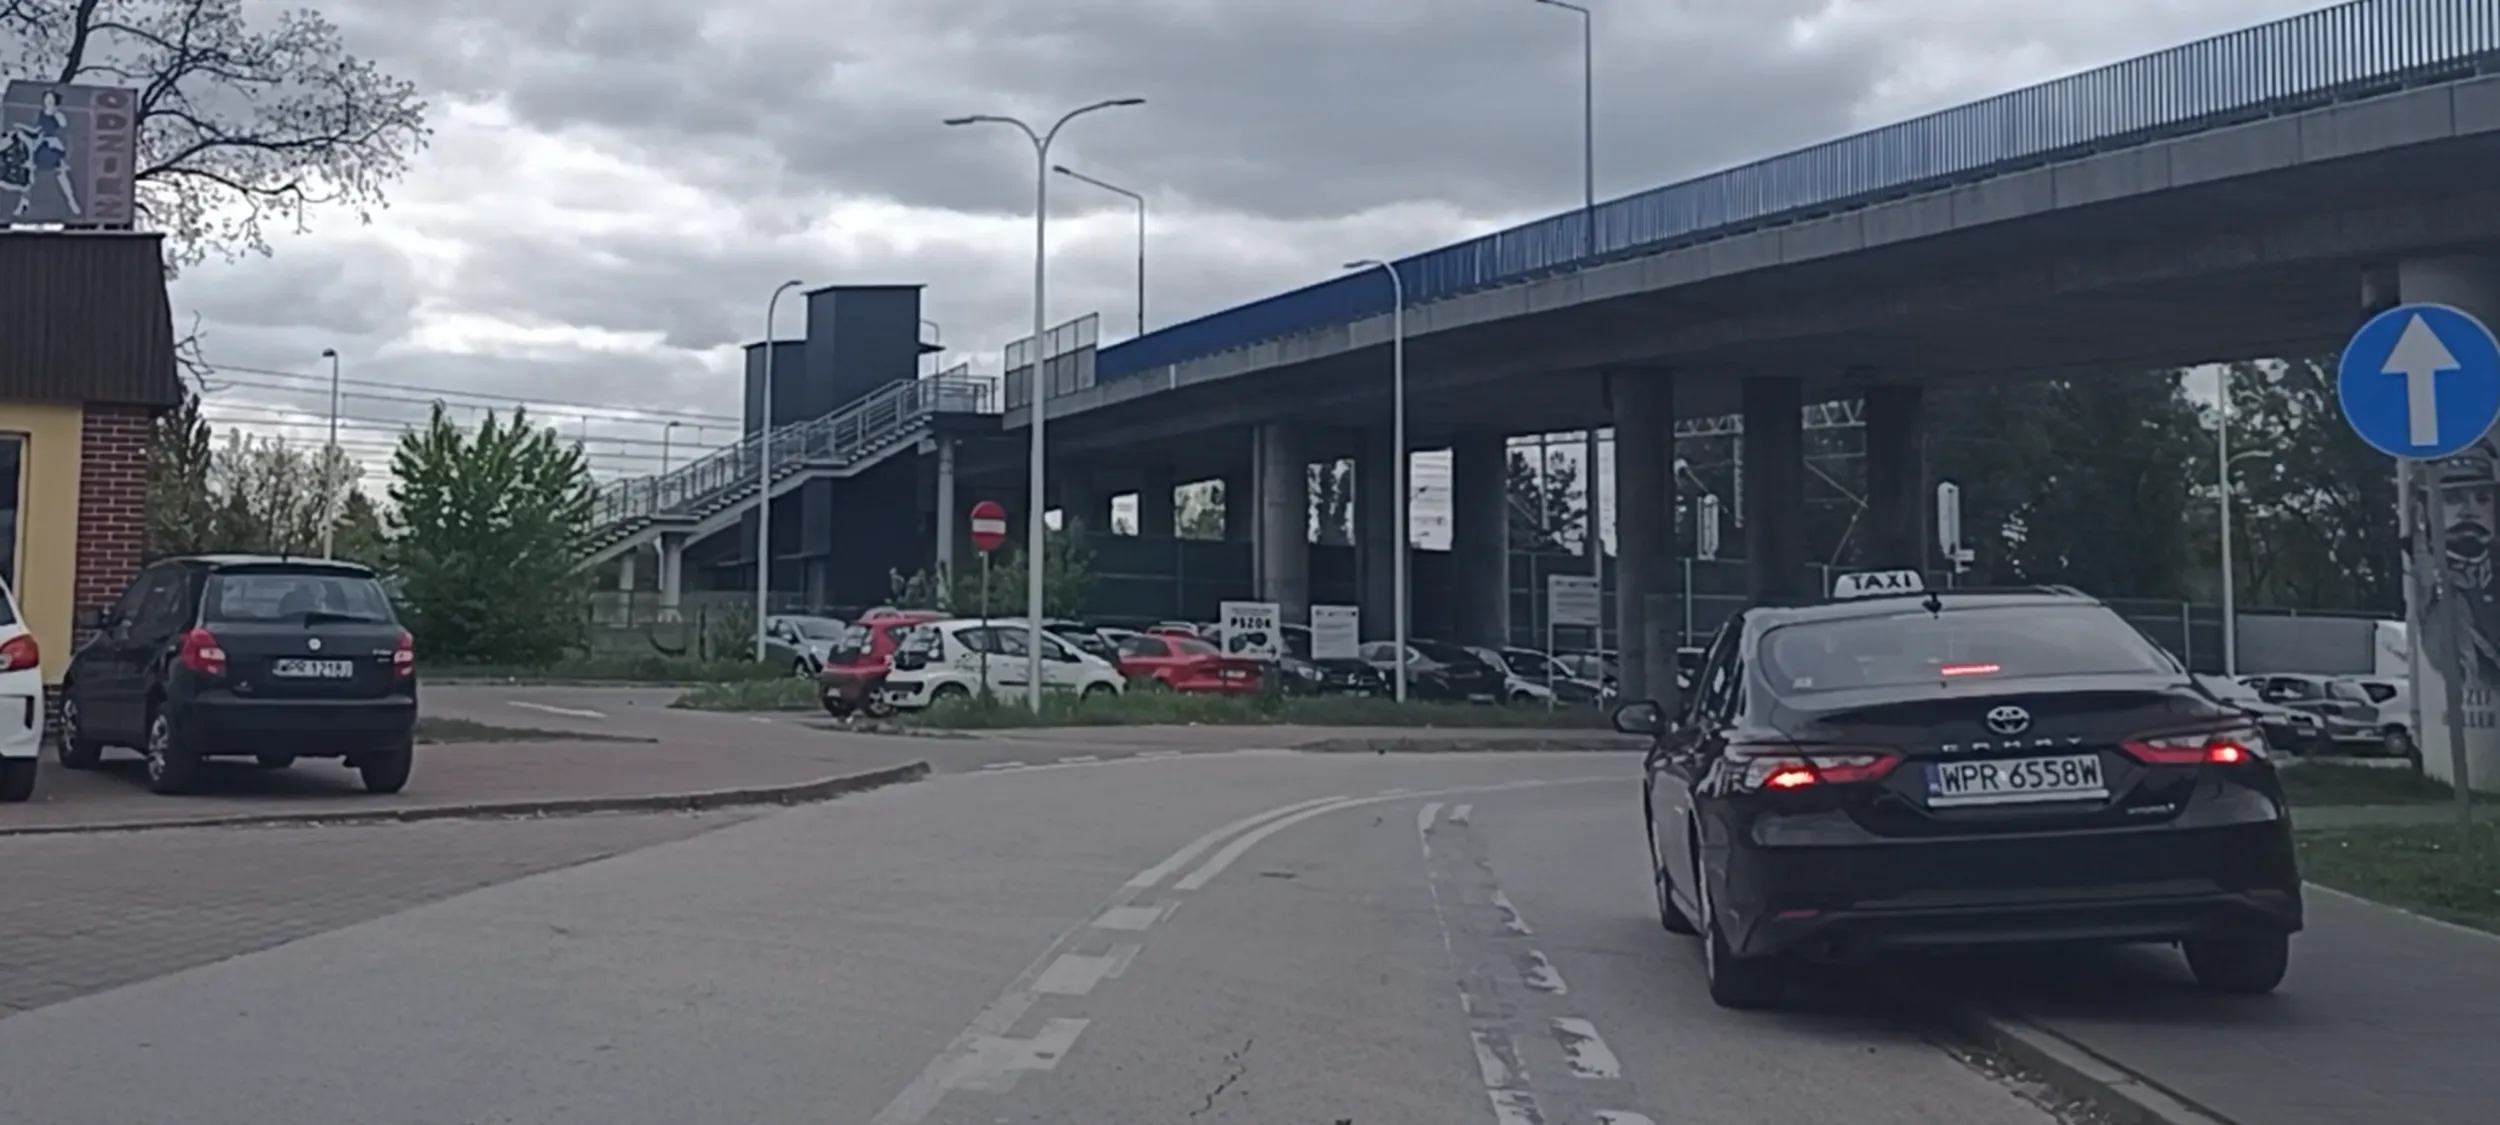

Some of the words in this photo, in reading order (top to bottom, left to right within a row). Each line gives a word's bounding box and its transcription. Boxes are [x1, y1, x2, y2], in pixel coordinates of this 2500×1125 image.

[1848, 573, 1912, 592] TAXI
[1230, 616, 1273, 630] PSZOK
[1942, 763, 2001, 792] WPR
[2008, 758, 2100, 789] 6558W
